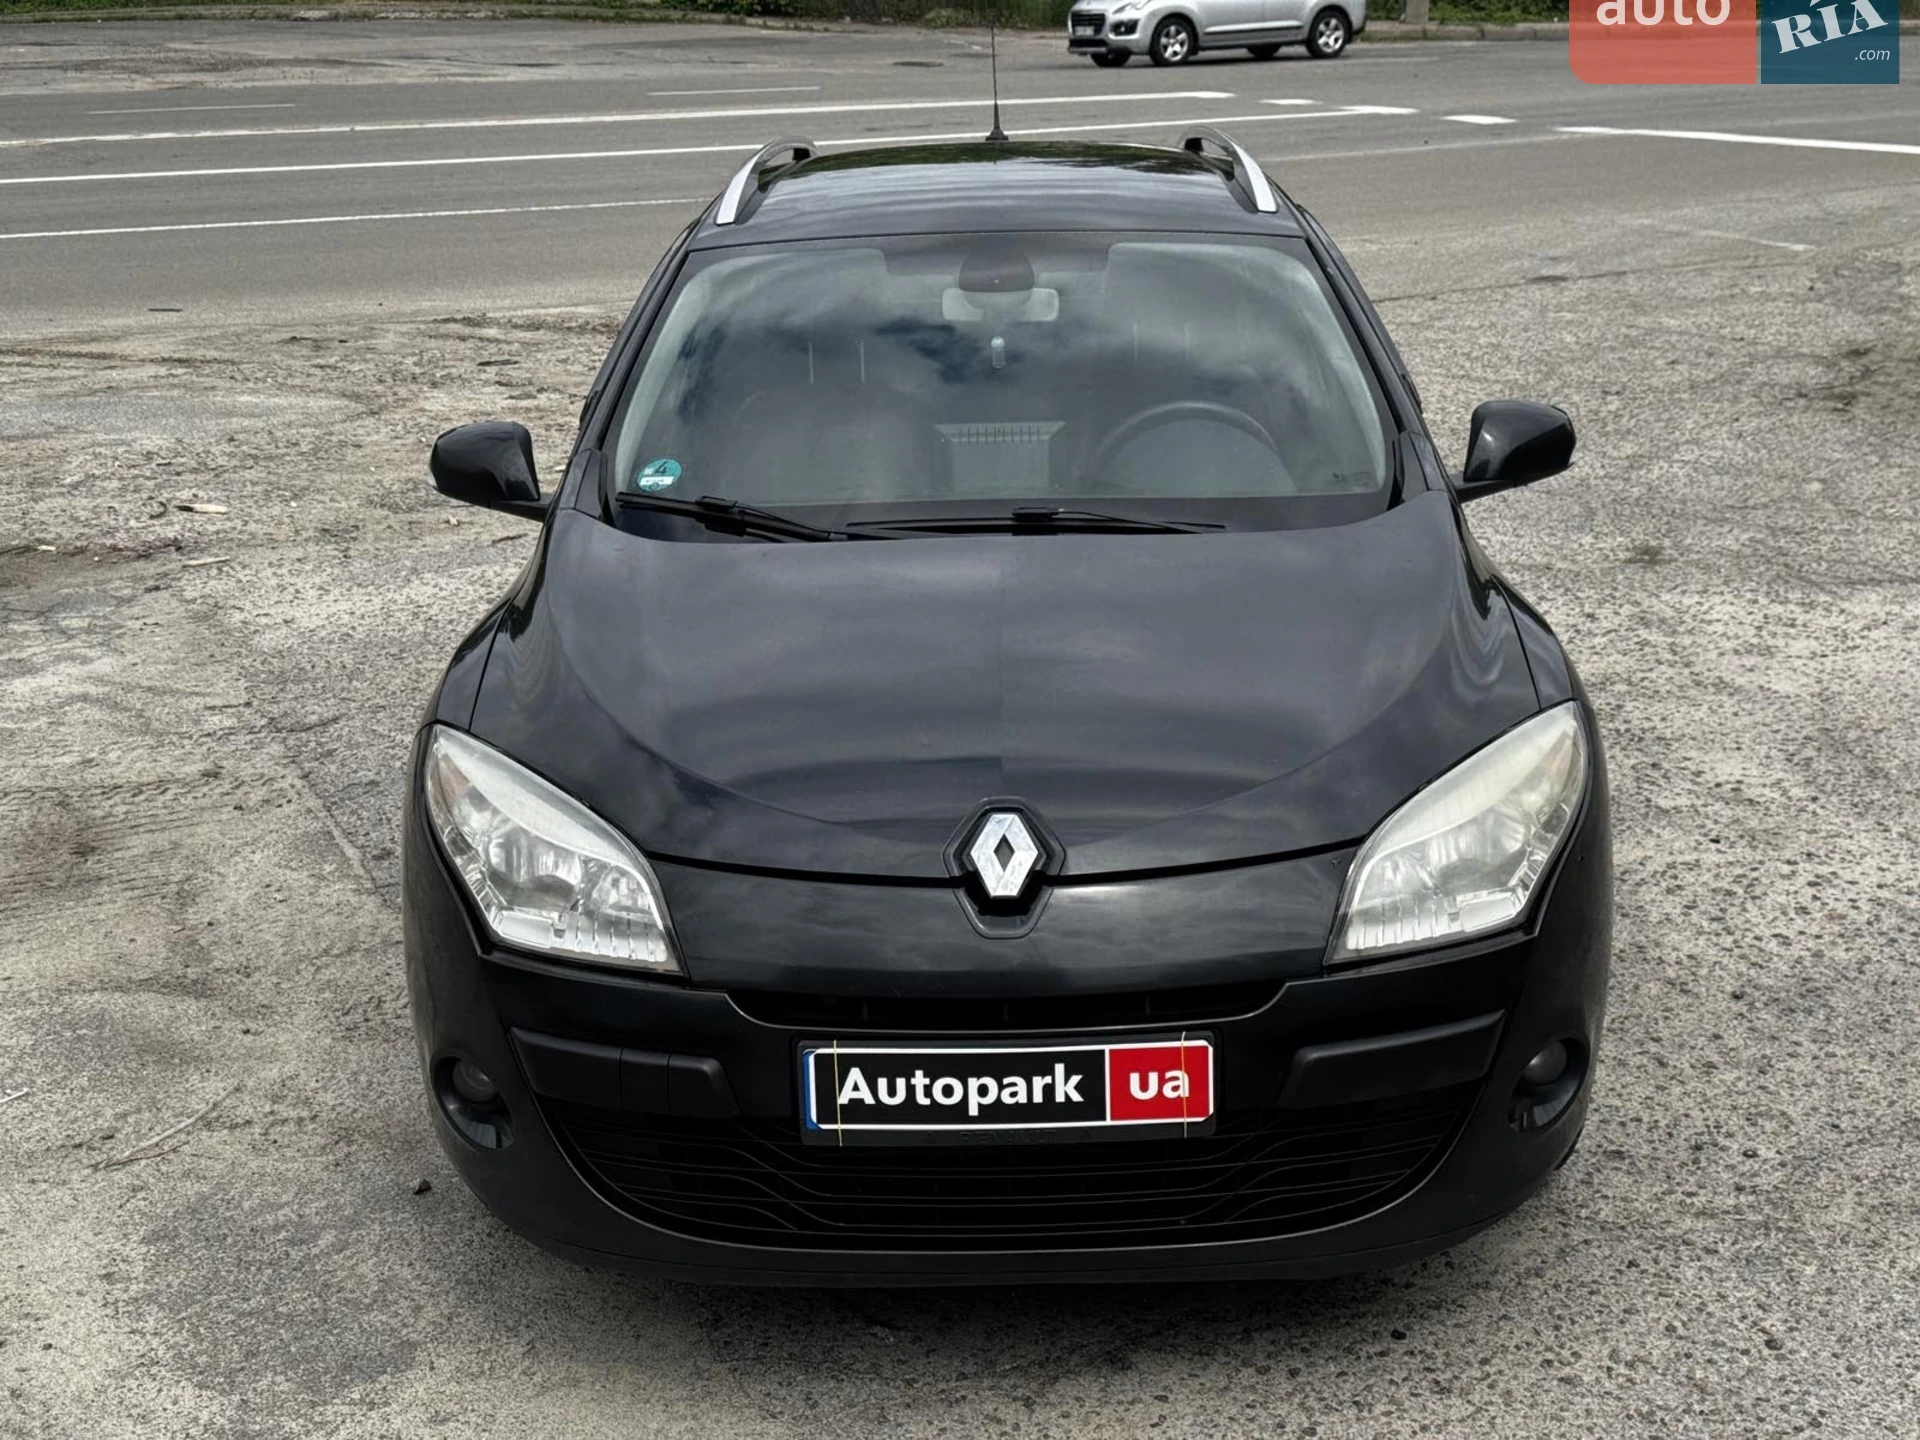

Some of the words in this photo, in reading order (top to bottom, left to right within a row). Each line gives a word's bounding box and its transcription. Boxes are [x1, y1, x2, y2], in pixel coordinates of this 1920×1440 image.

[654, 460, 668, 475] 4
[838, 1062, 1085, 1116] Autopark
[1129, 1067, 1191, 1100] ua
